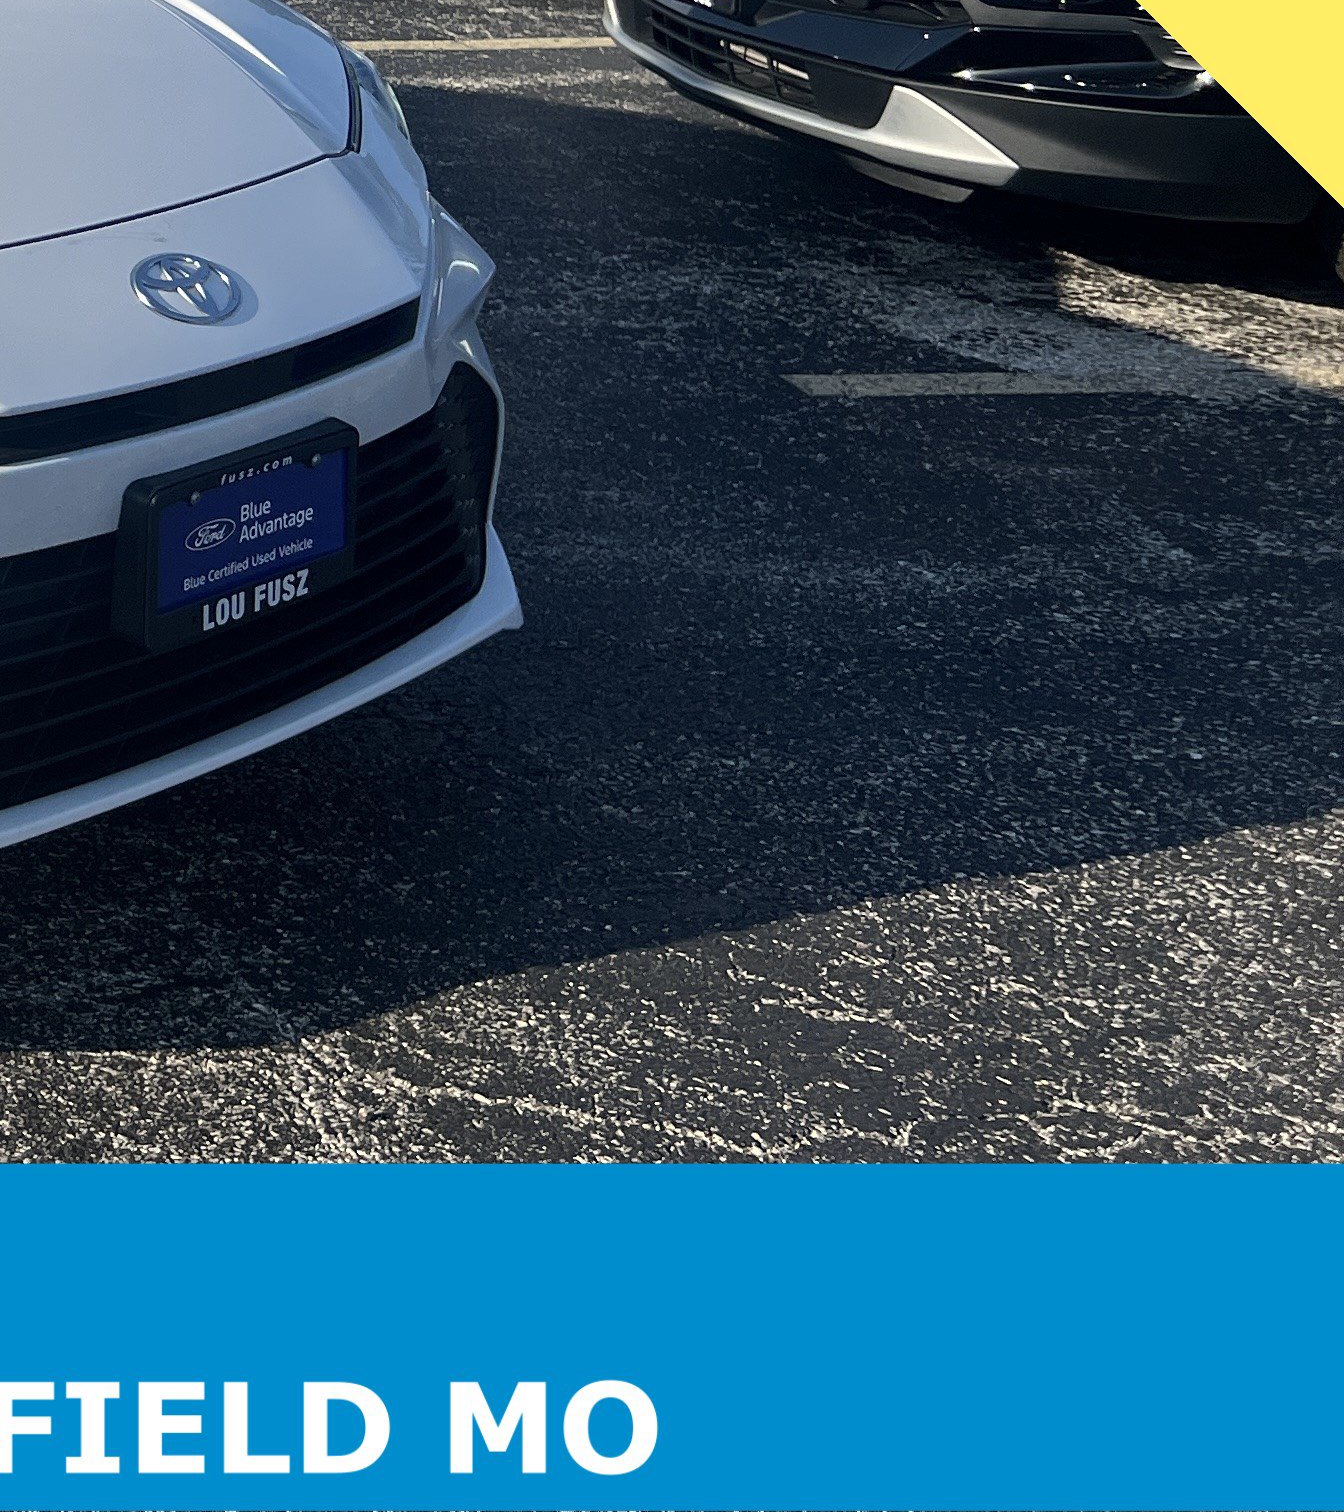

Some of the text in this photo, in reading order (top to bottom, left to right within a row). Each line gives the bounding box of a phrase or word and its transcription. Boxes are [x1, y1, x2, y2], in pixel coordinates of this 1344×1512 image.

[220, 455, 293, 486] fusz.com
[239, 507, 314, 543] Advantage
[240, 500, 272, 523] Blue
[195, 523, 227, 548] Ford
[183, 538, 314, 591] Blue Certified Used Vehicle
[203, 568, 310, 631] LOU FUSZ
